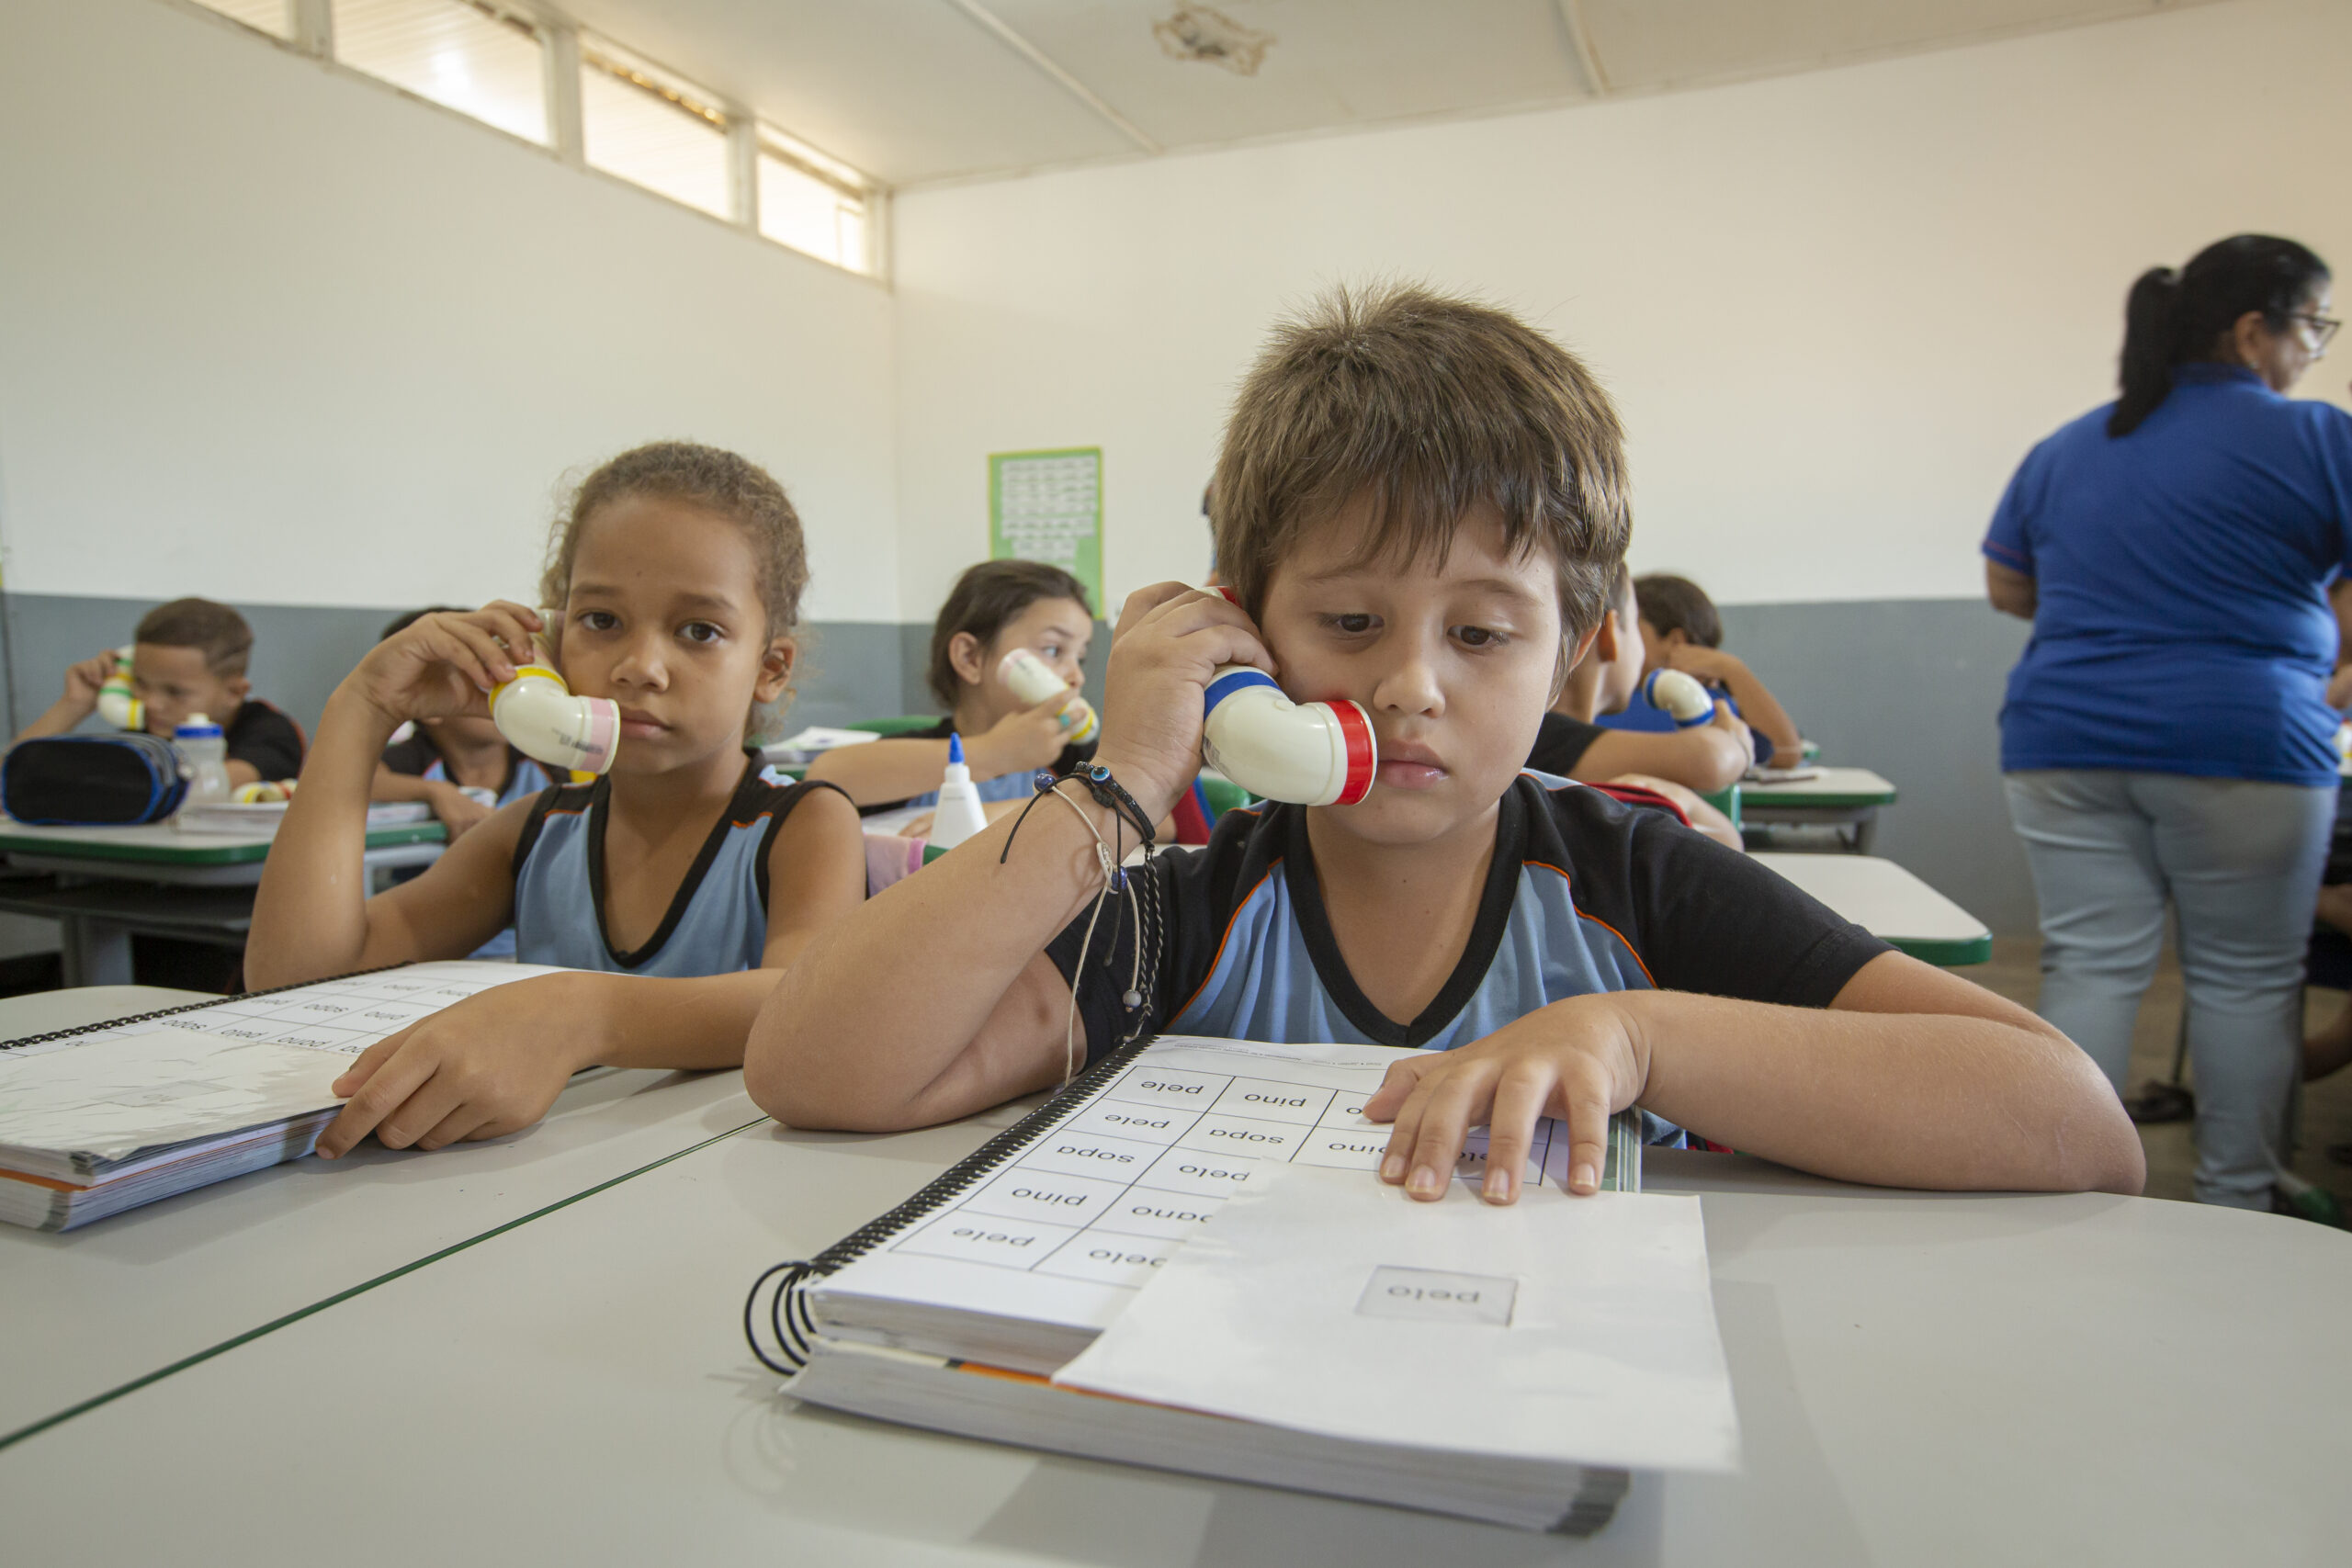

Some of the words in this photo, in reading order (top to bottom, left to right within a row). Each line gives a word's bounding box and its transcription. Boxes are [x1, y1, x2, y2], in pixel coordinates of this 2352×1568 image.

[161, 1017, 208, 1030] sopa
[220, 1026, 268, 1039] pelo
[277, 1035, 332, 1047] pano
[1140, 1080, 1204, 1095] pele
[1244, 1093, 1307, 1108] pino
[1104, 1114, 1171, 1129] pele
[1208, 1129, 1284, 1144] sopa
[1056, 1145, 1136, 1163] sopa
[1179, 1165, 1250, 1181] pelo
[1012, 1188, 1088, 1206] pino
[952, 1228, 1036, 1247] pele
[1386, 1286, 1480, 1304] pelo
